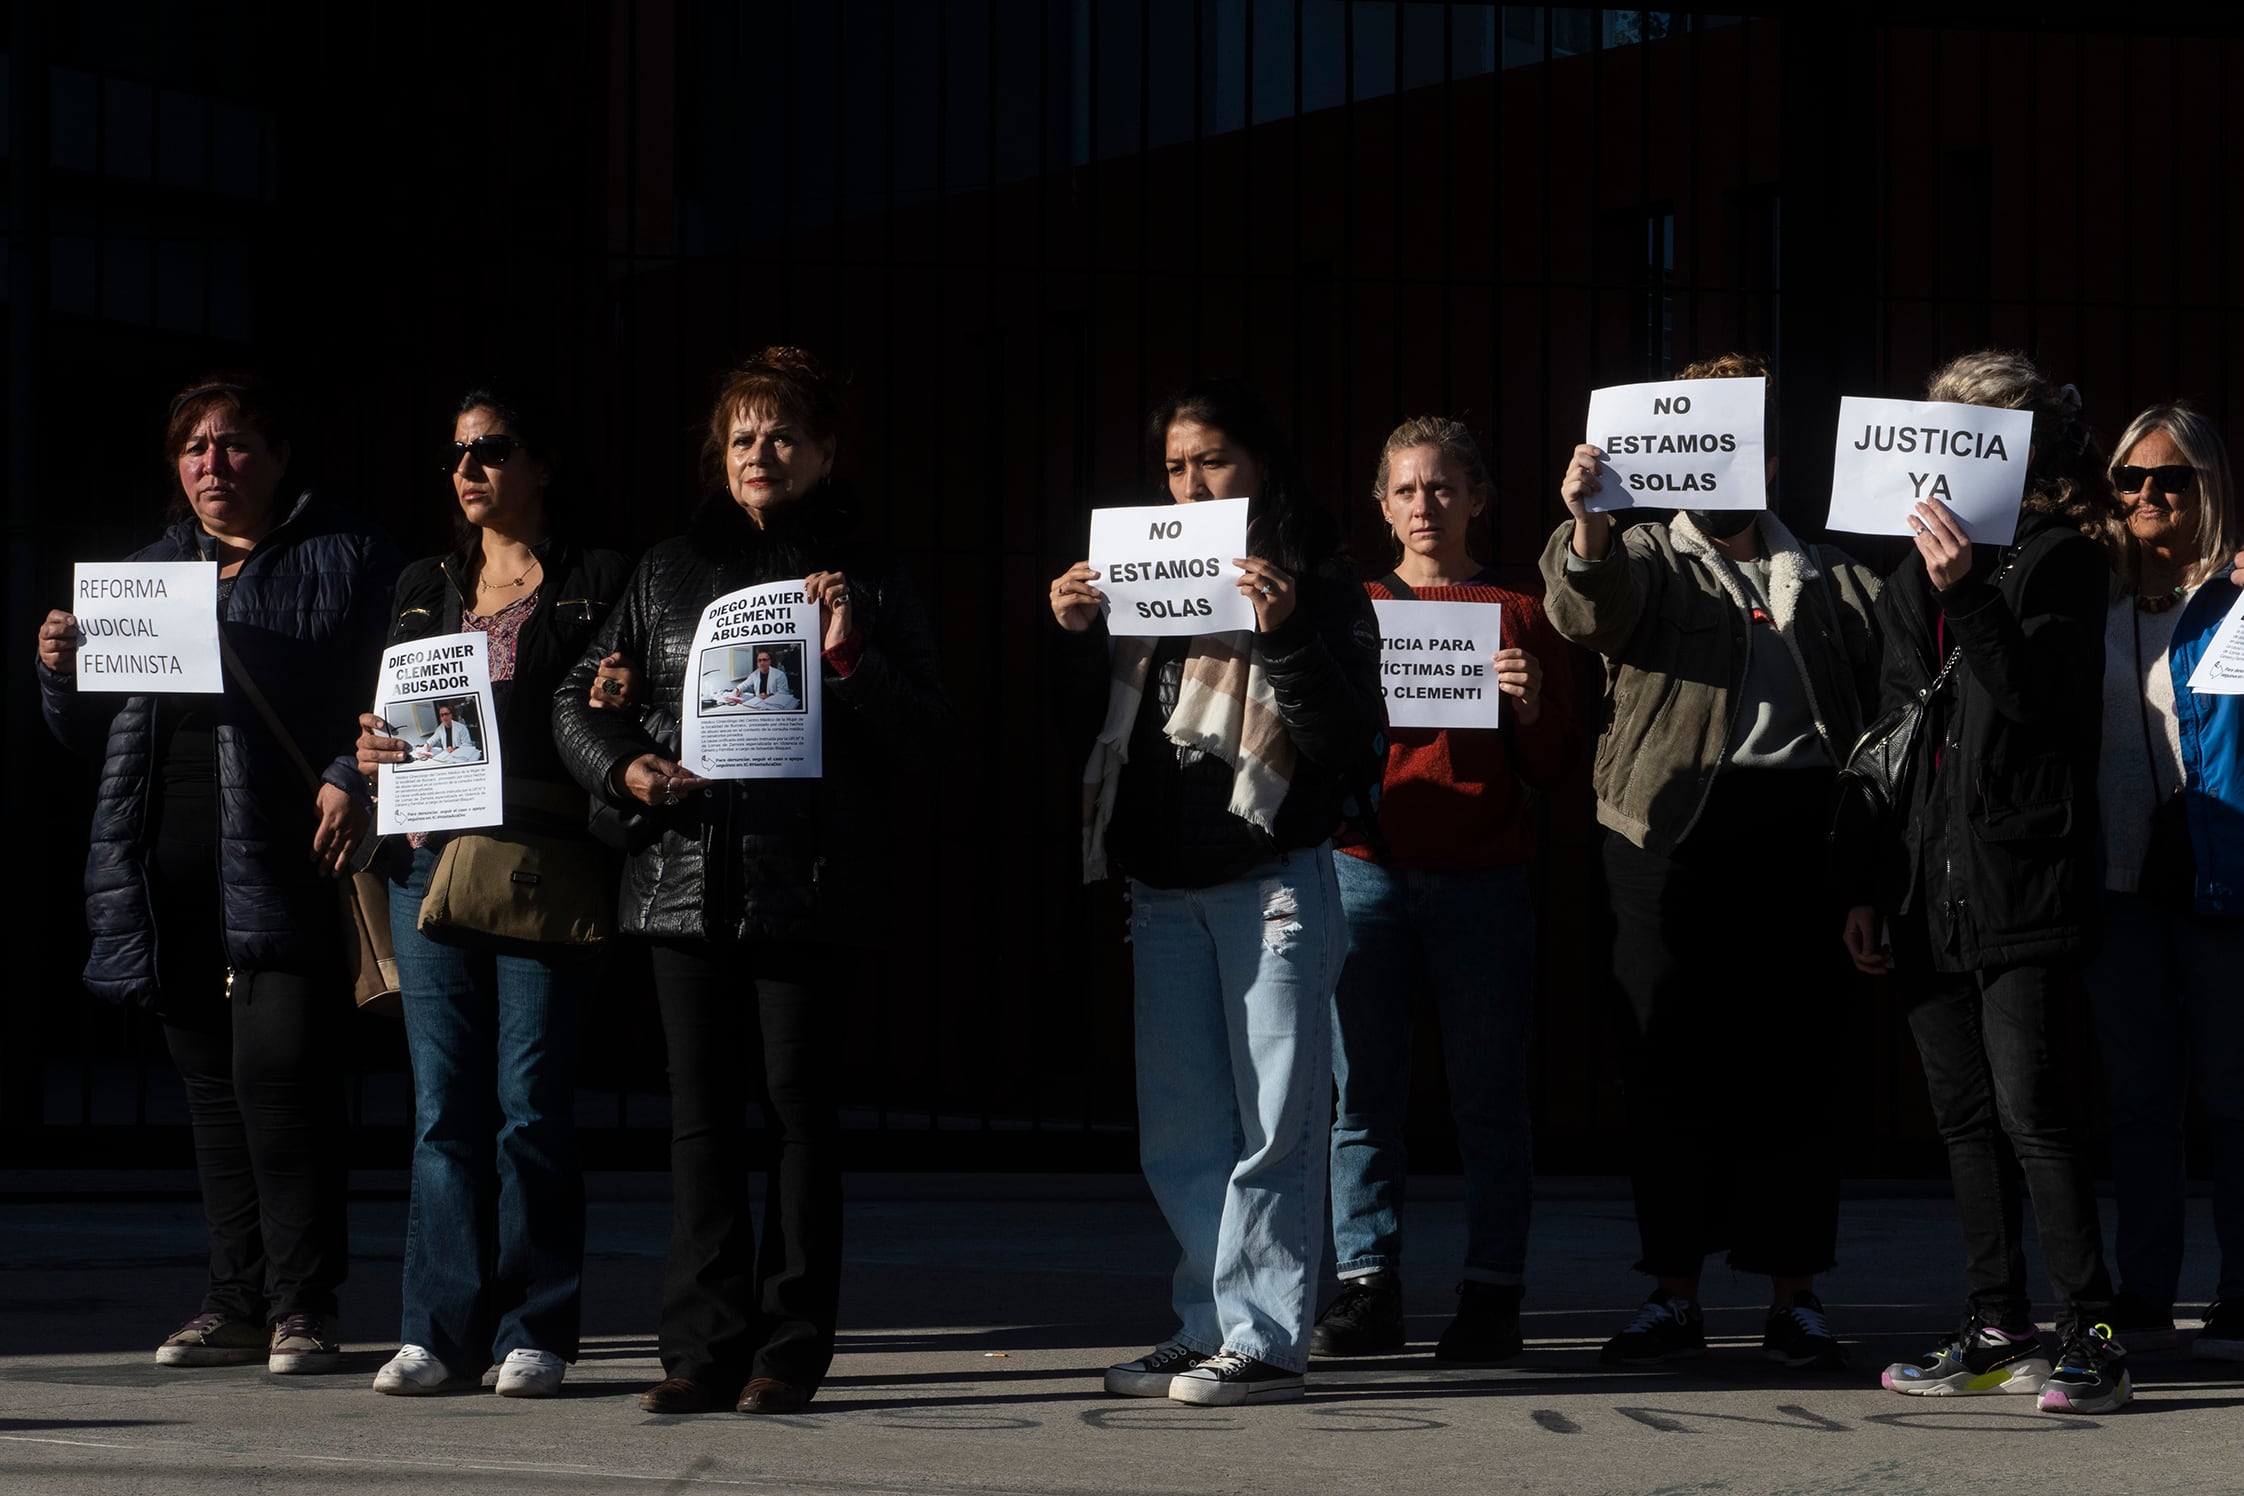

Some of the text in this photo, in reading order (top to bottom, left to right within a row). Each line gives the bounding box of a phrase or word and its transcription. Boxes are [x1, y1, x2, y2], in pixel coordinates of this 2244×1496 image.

[1653, 396, 1691, 415] NO
[1607, 433, 1736, 454] ESTAMOS
[1854, 424, 2008, 461] JUSTICIA
[1629, 473, 1717, 492] SOLAS
[1908, 472, 1952, 501] YA
[1149, 520, 1183, 540] NO
[1109, 557, 1220, 583] ESTAMOS
[80, 579, 168, 598] REFORMA
[709, 592, 804, 619] DIEGO JAVIER
[1136, 598, 1212, 618] SOLAS
[79, 618, 159, 637] JUDICIAL
[716, 607, 791, 628] CLEMENTI
[710, 622, 796, 642] ABUSADOR
[1429, 639, 1475, 652] PARA
[84, 654, 183, 674] FEMINISTA
[389, 645, 474, 669] DIEGO JAVIER
[396, 661, 463, 680] CLEMENTI
[1461, 664, 1484, 677] DE
[393, 675, 469, 696] ABUSADOR
[1394, 686, 1482, 700] CLEMENTI
